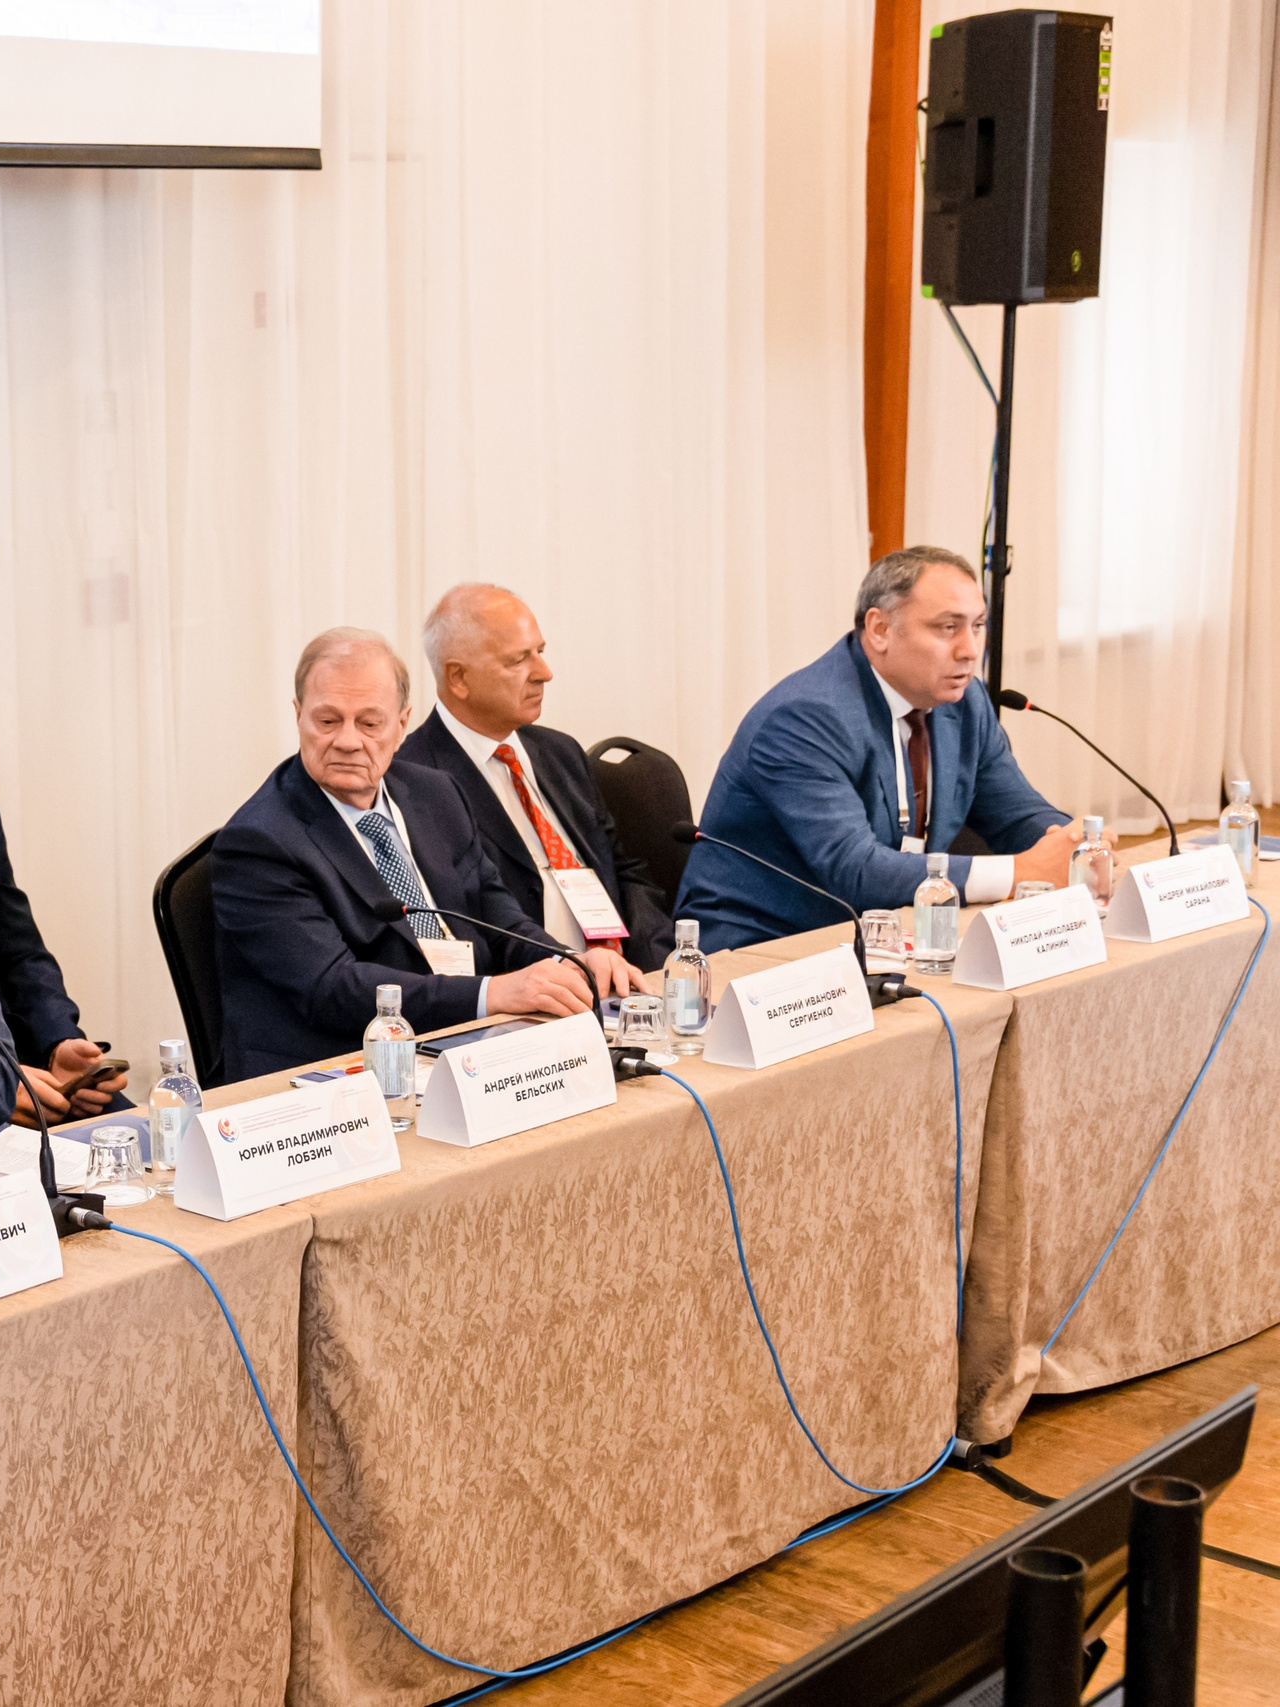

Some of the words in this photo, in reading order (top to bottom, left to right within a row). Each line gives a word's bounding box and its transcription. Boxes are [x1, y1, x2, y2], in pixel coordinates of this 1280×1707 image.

[1159, 888, 1184, 902] АНДРЕЙ
[1185, 877, 1229, 895] МИХАЙЛОВИЧ
[1185, 896, 1211, 909] САРАНА
[1010, 931, 1043, 947] НИКОЛАЙ
[1044, 919, 1087, 939] НИКОЛАЕВИЧ
[1036, 939, 1069, 954] КАЛИНИН
[767, 998, 804, 1020] ВАЛЕРИЙ
[805, 986, 847, 1009] ИВАНОВИЧ
[789, 1007, 834, 1029] СЕРГИЕНКО
[484, 1072, 523, 1094] АНДРЕЙ
[525, 1055, 588, 1084] НИКОЛАЕВИЧ
[515, 1078, 565, 1102] БЕЛЬСКИХ
[238, 1140, 275, 1162] ЮРИЙ
[277, 1116, 370, 1152] ВЛАДИМИРОВИЧ
[287, 1145, 333, 1167] ЛОБЗИН
